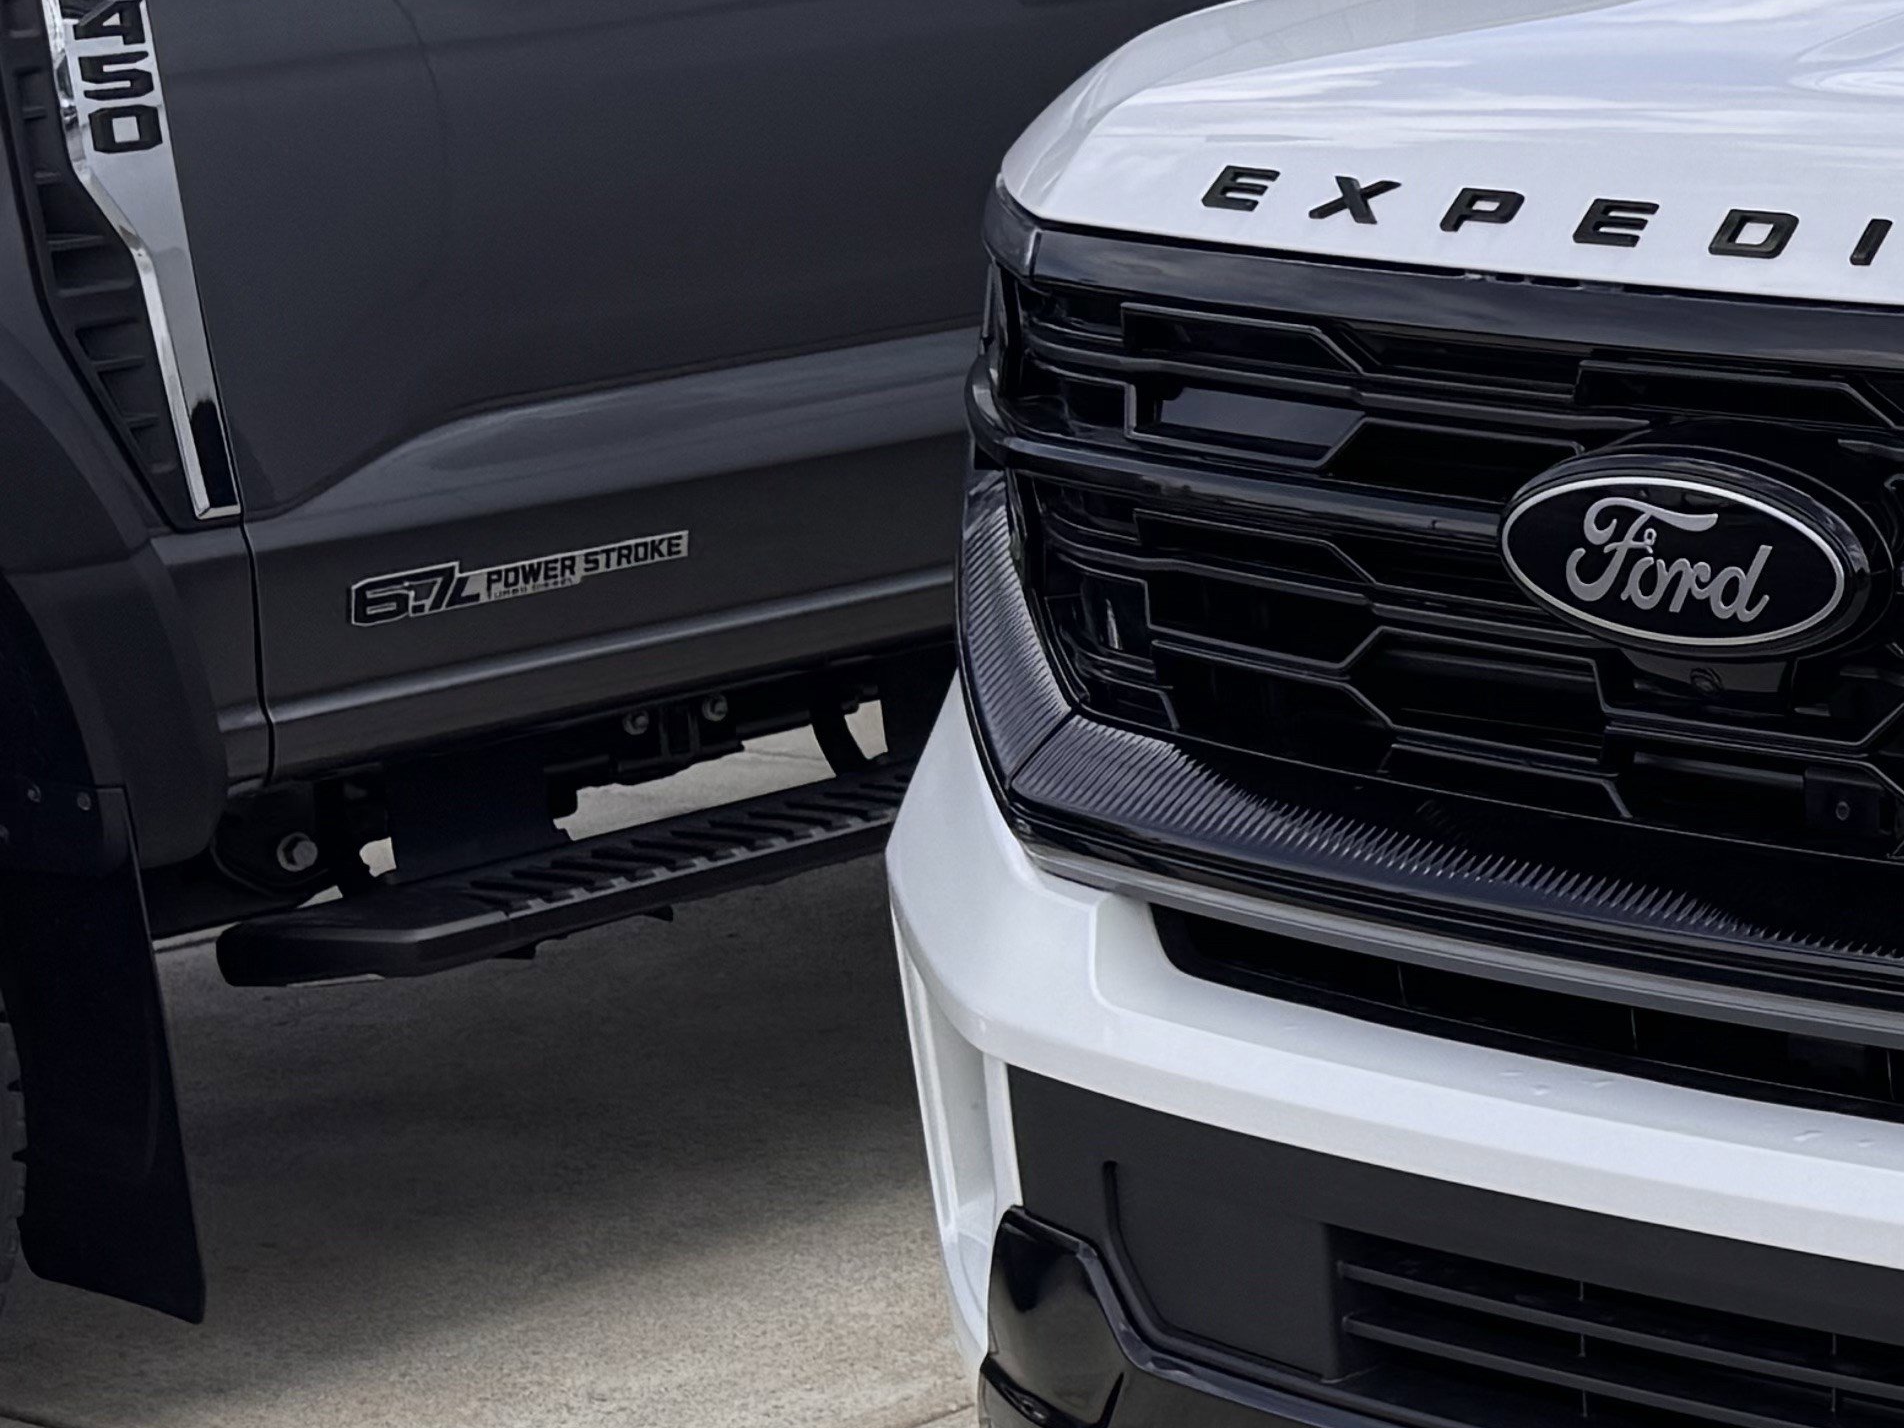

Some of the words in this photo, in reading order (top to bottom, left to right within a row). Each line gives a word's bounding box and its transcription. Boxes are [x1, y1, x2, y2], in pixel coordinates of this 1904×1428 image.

[353, 562, 481, 625] 6.7L
[486, 554, 577, 590] POWER
[583, 534, 684, 573] STROKE
[1565, 496, 1775, 623] Ford
